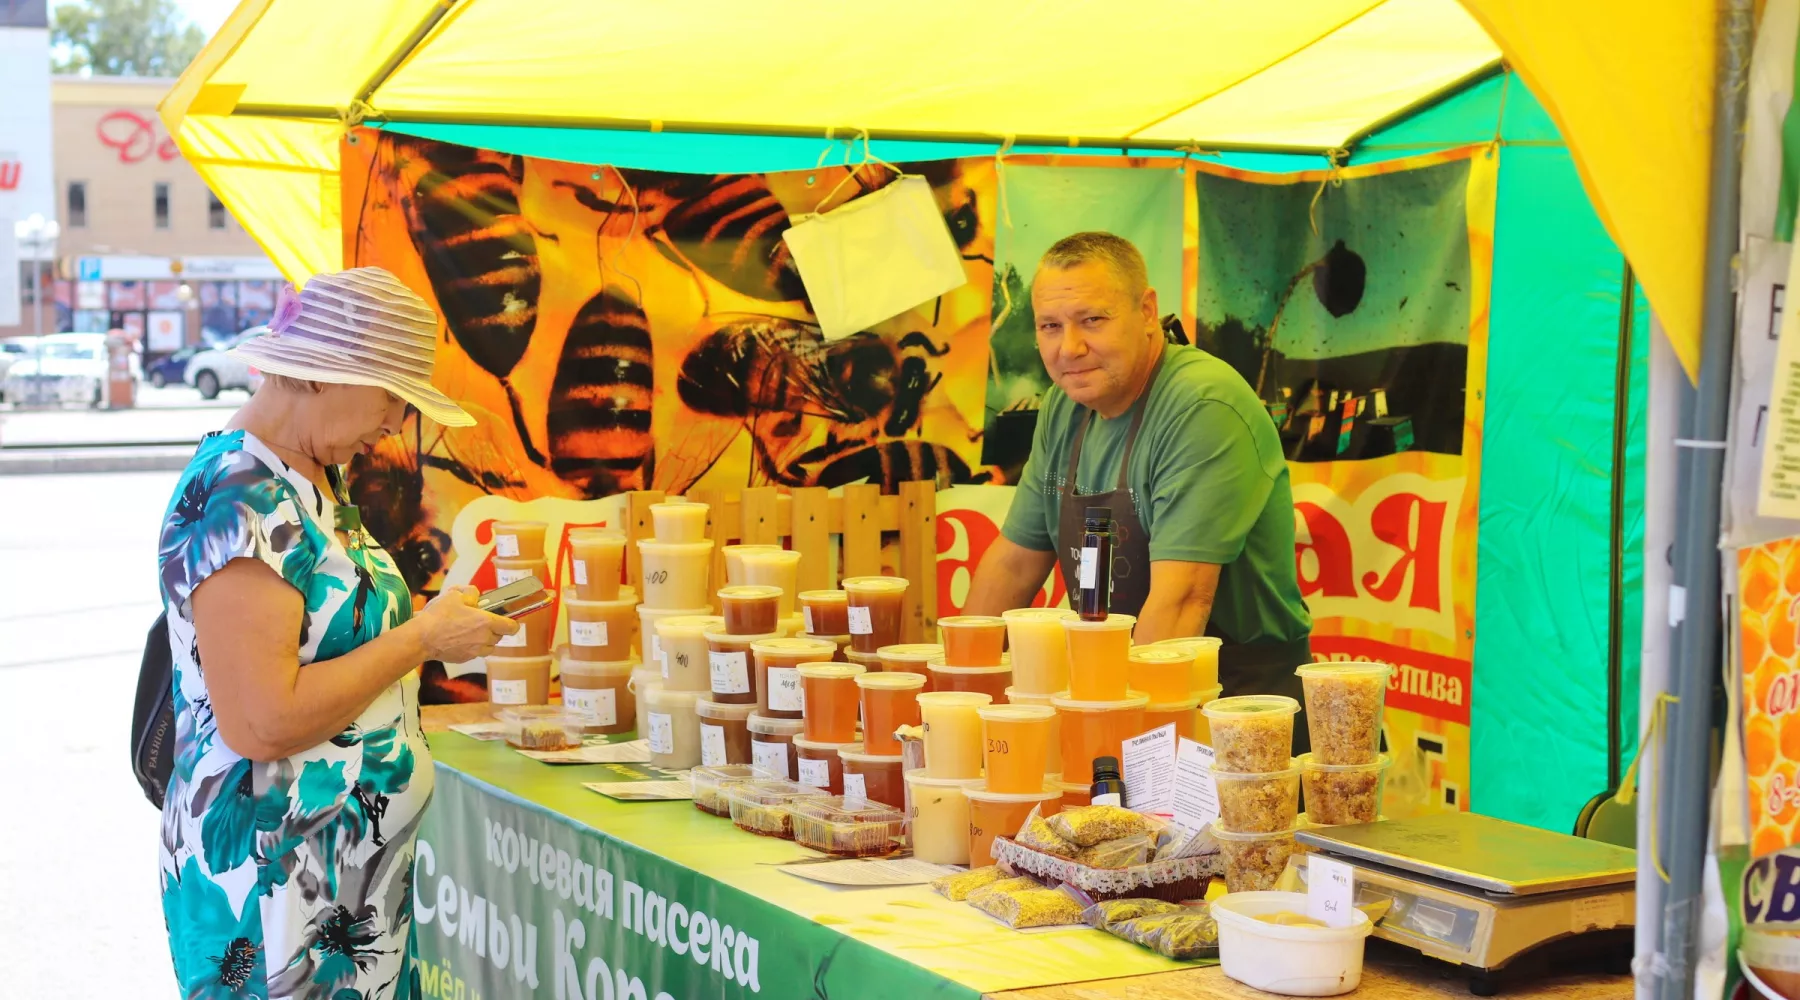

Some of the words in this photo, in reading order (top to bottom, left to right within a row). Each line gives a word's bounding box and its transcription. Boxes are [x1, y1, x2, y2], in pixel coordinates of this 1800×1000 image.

[149, 719, 169, 769] FASHION
[988, 738, 1009, 754] 300
[413, 838, 540, 990] Семьи
[485, 817, 614, 921] кочевая
[622, 879, 761, 994] пасека
